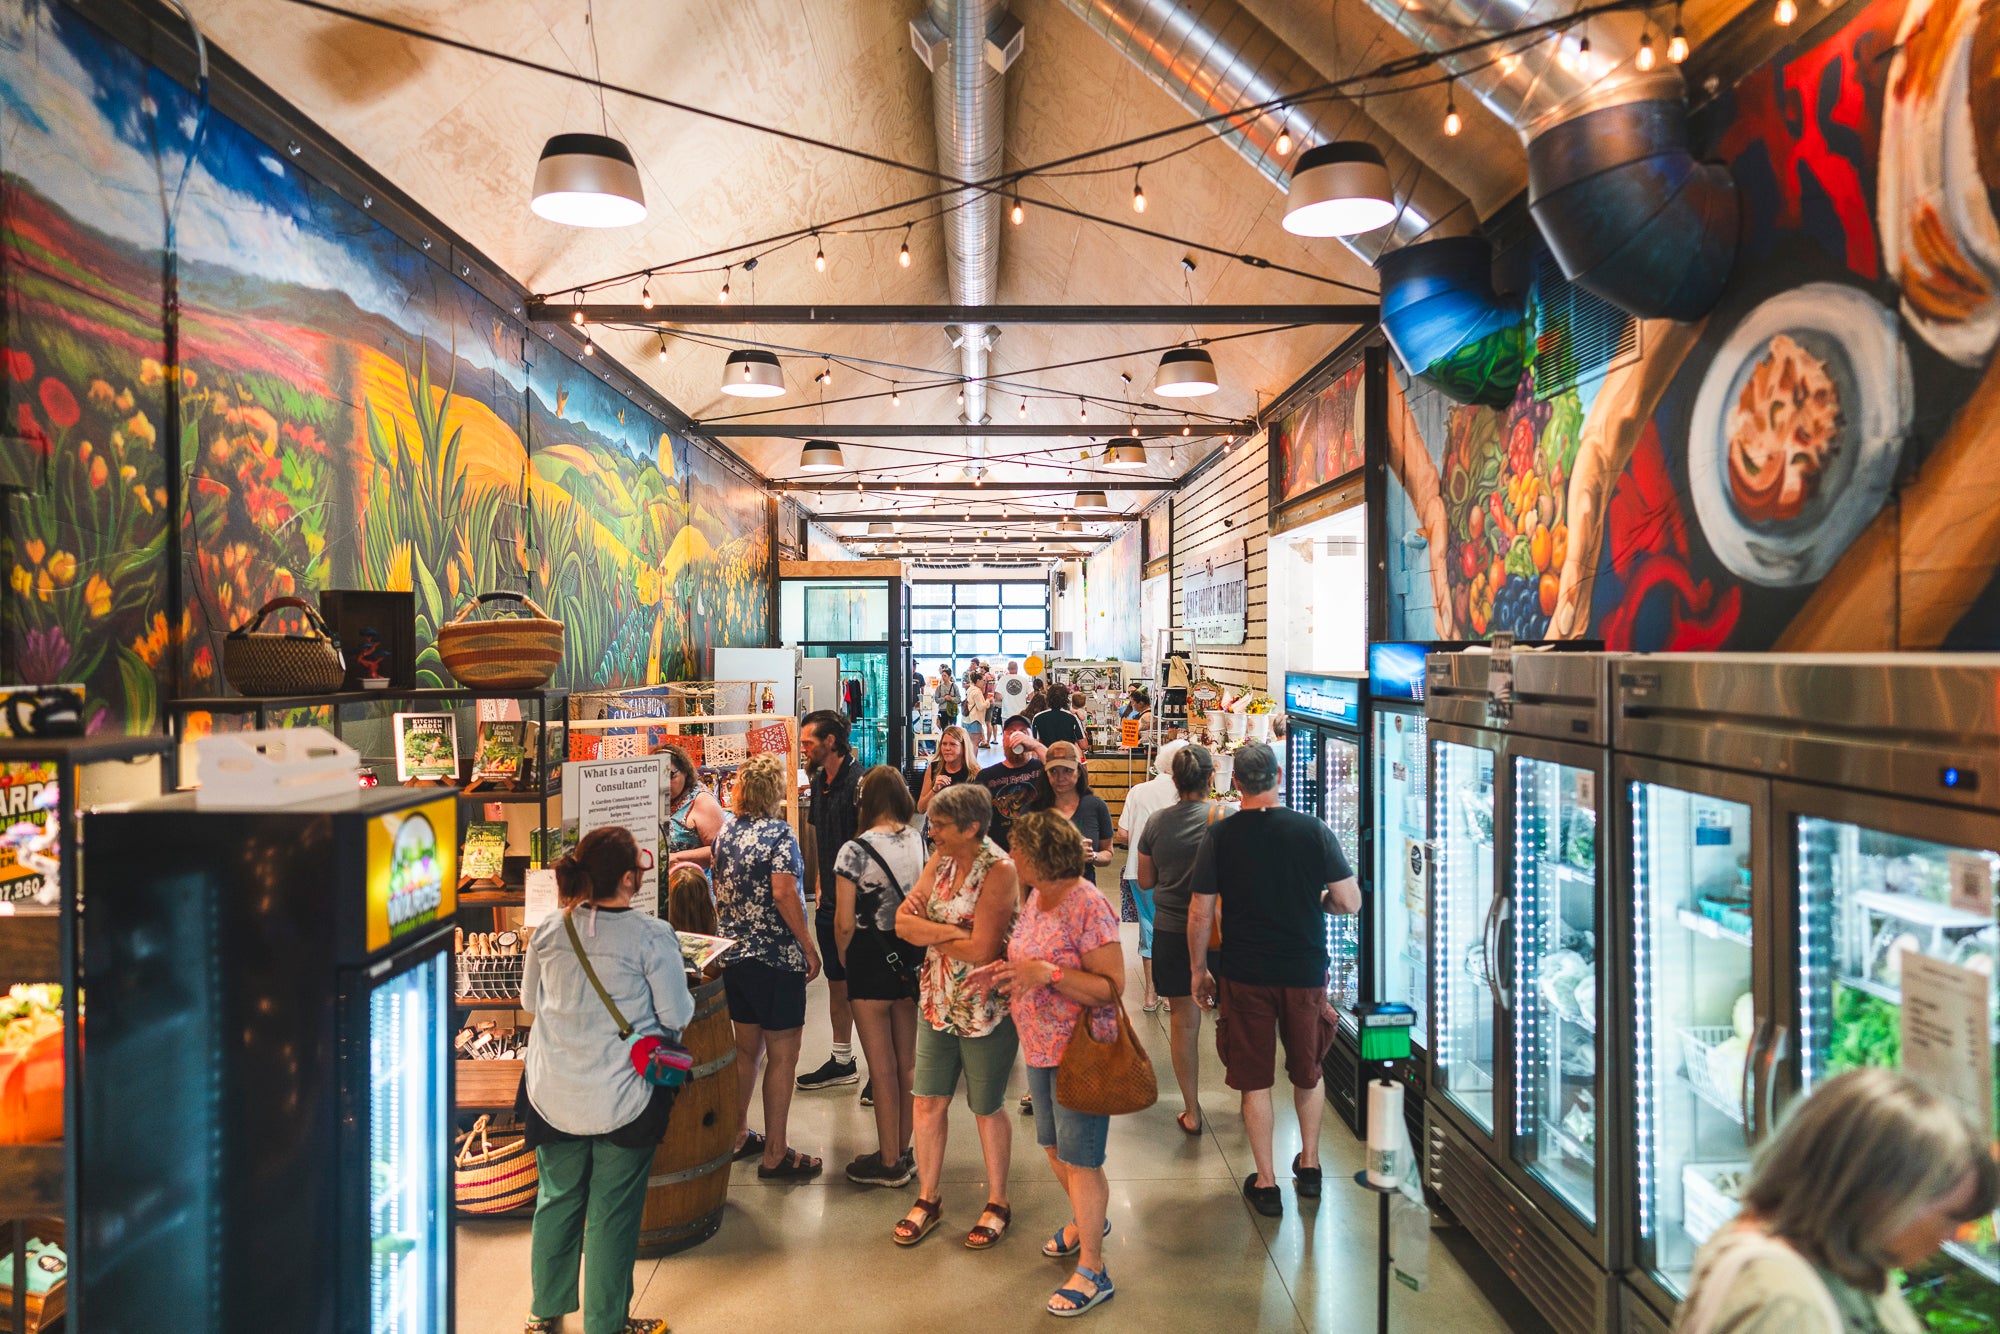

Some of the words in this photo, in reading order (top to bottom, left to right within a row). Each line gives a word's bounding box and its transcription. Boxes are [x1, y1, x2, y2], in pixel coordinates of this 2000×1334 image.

[583, 767, 608, 779] What
[610, 767, 617, 777] Is
[626, 763, 658, 775] Garden
[595, 779, 647, 793] Consultant?
[608, 804, 630, 812] gardening
[0, 877, 40, 902] 7.260
